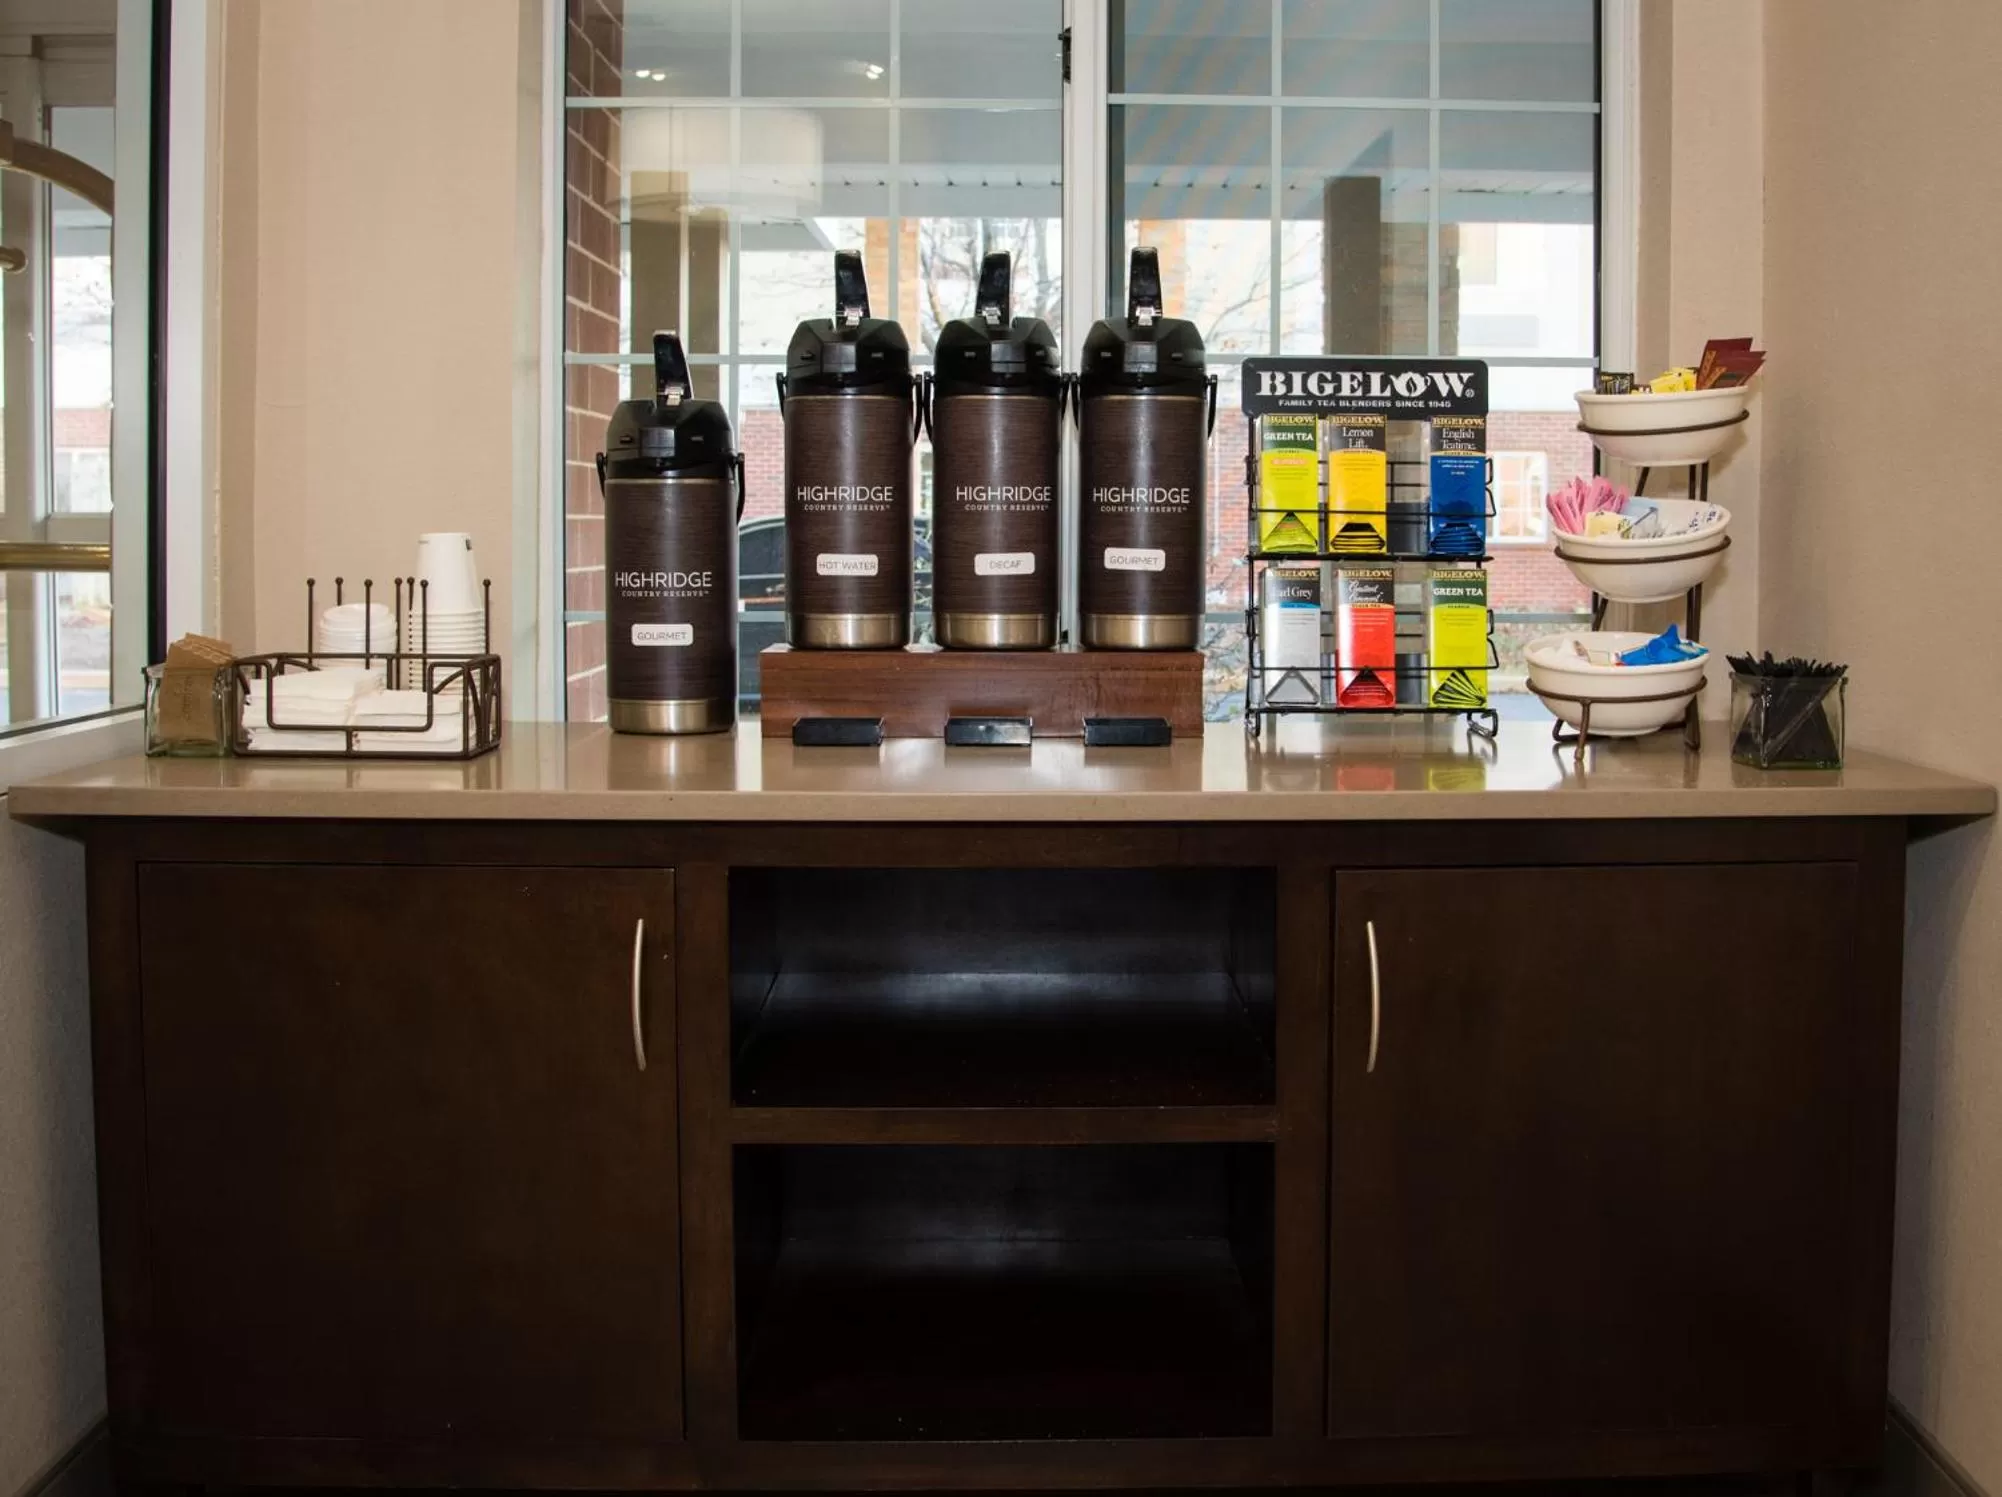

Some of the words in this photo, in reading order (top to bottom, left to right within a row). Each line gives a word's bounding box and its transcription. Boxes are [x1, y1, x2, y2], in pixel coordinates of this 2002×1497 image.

[1256, 371, 1475, 398] BIGELOW
[1278, 399, 1313, 408] FAMILY
[1317, 399, 1336, 408] TEA
[1339, 400, 1392, 408] BLENDERS
[1395, 400, 1425, 408] SINCE
[1432, 417, 1485, 426] BIGELOW
[1263, 431, 1294, 440] GREEN
[1296, 432, 1314, 441] TEA
[1343, 427, 1374, 438] Lemon
[1442, 428, 1475, 442] English
[797, 486, 894, 501] HIGHRIDGE
[956, 486, 1052, 501] HIGHRIDGE
[1093, 487, 1190, 504] HIGHRIDGE
[819, 561, 840, 570] HOT
[842, 560, 876, 571] WATER
[989, 560, 1022, 570] DECAF
[1109, 555, 1158, 566] GOURMET
[614, 571, 713, 588] HIGHRIDGE
[1432, 570, 1484, 579] BIGELOW
[1291, 586, 1313, 600] Grey
[1433, 587, 1464, 596] GREEN
[1465, 587, 1484, 597] TEA
[636, 631, 688, 641] GOURMET
